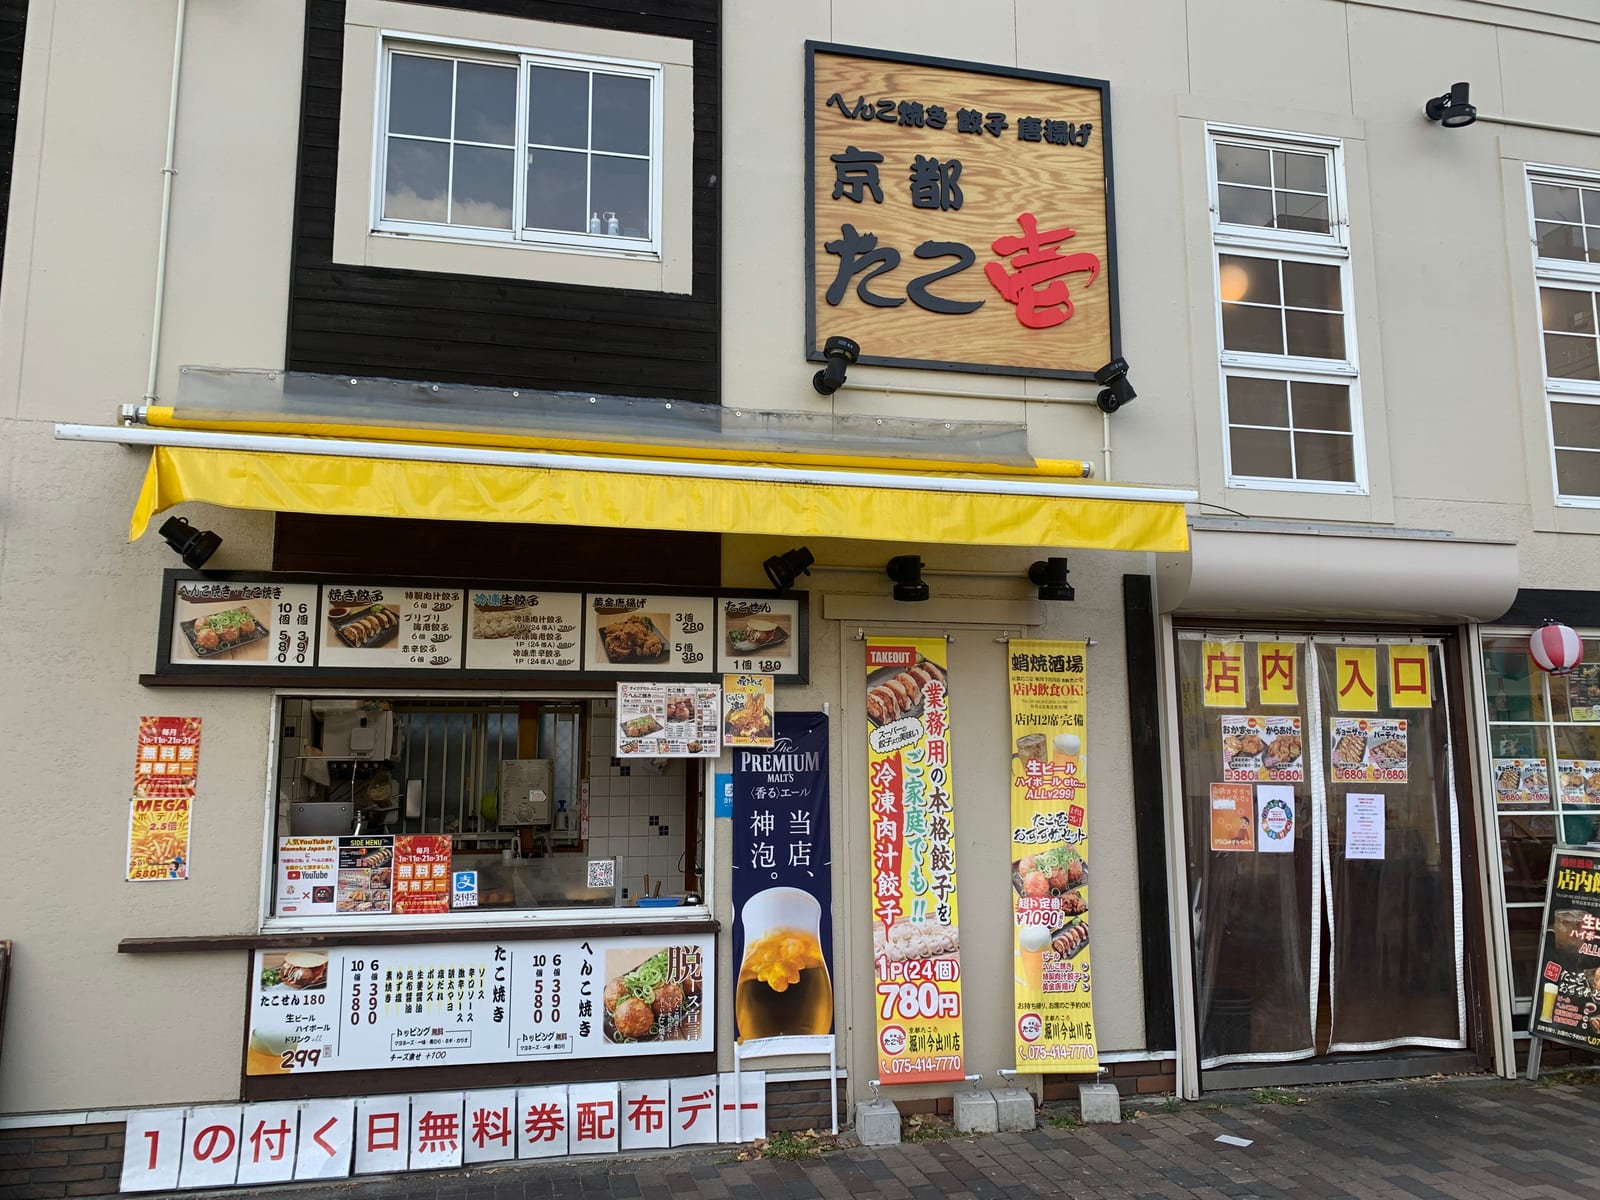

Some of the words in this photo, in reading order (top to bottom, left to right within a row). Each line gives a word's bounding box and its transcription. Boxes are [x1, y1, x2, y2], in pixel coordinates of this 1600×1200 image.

[826, 93, 947, 129] へんこ焼き
[956, 108, 1009, 137] 餃子
[1017, 116, 1093, 147] 唐揚げ
[830, 145, 963, 211] 京都
[824, 213, 1100, 329] たこ壱
[328, 588, 384, 601] 焼き餃子
[433, 602, 452, 610] 280
[723, 600, 772, 613] たこせん
[682, 622, 704, 632] 280
[682, 652, 704, 662] 380
[870, 651, 911, 663] TAKEOUT
[758, 660, 781, 671] 180
[1013, 682, 1083, 697] 店内飲食OK!
[1015, 713, 1084, 726] 店内12席完備
[162, 728, 177, 736] 毎月
[767, 737, 799, 753] The
[142, 747, 193, 759] 無料券
[140, 762, 193, 773] 配布デー
[741, 751, 820, 772] PREMIUM
[1026, 760, 1076, 776] 生ビール
[768, 772, 794, 783] MALT'S
[1233, 770, 1255, 780] 380
[1278, 770, 1299, 781] 680
[1344, 769, 1363, 780] 680
[1015, 777, 1061, 787] ハイボール
[136, 799, 188, 811] MEGA
[924, 681, 952, 922] 業務用の本格餃子を
[873, 761, 901, 925] 冷凍肉汁餃子
[136, 869, 167, 878] 580円
[302, 871, 329, 879] YouTube
[399, 864, 446, 878] 無料券
[397, 880, 446, 891] 配布デー
[492, 945, 507, 1023] たこ焼き
[578, 941, 593, 1038] へんこ焼き
[260, 994, 300, 1007] たこせん
[303, 994, 325, 1005] 180
[878, 982, 959, 1018] 780円
[285, 1013, 315, 1023] 生ビール
[296, 1024, 330, 1032] ハイボール
[396, 1026, 431, 1037] トッピング
[284, 1035, 311, 1043] ドリンク
[522, 1031, 555, 1042] トッピング
[425, 1051, 447, 1061] +100
[1029, 1045, 1094, 1060] 075-414-7770
[281, 1049, 321, 1069] 299
[892, 1056, 960, 1073] 075-414-7770
